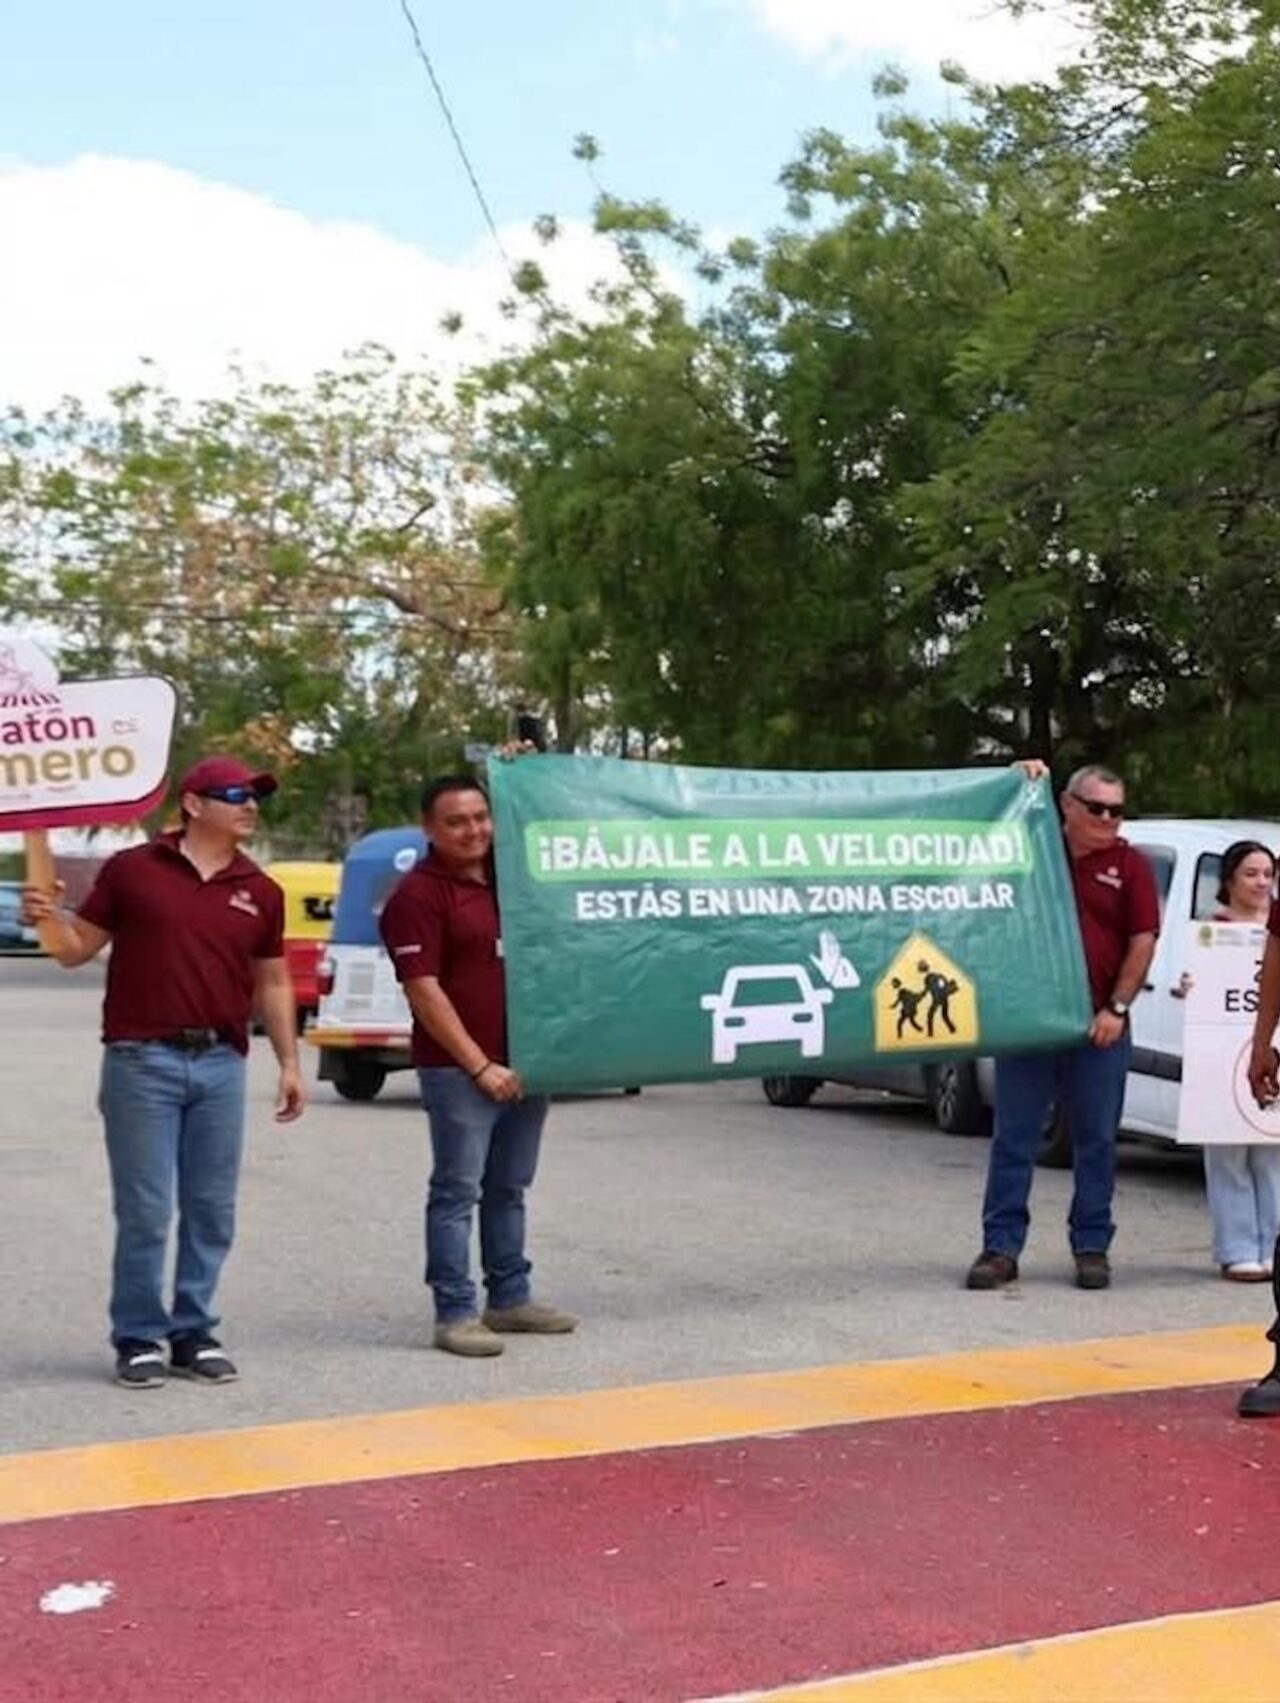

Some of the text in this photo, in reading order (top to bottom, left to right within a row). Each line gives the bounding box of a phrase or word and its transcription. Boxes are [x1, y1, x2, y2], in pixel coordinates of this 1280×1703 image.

[539, 825, 714, 871] ¡BÁJALE
[722, 834, 749, 868] A
[757, 833, 810, 868] LA
[575, 882, 1015, 920] ESTÁS EN UNA ZONA ESCOLAR
